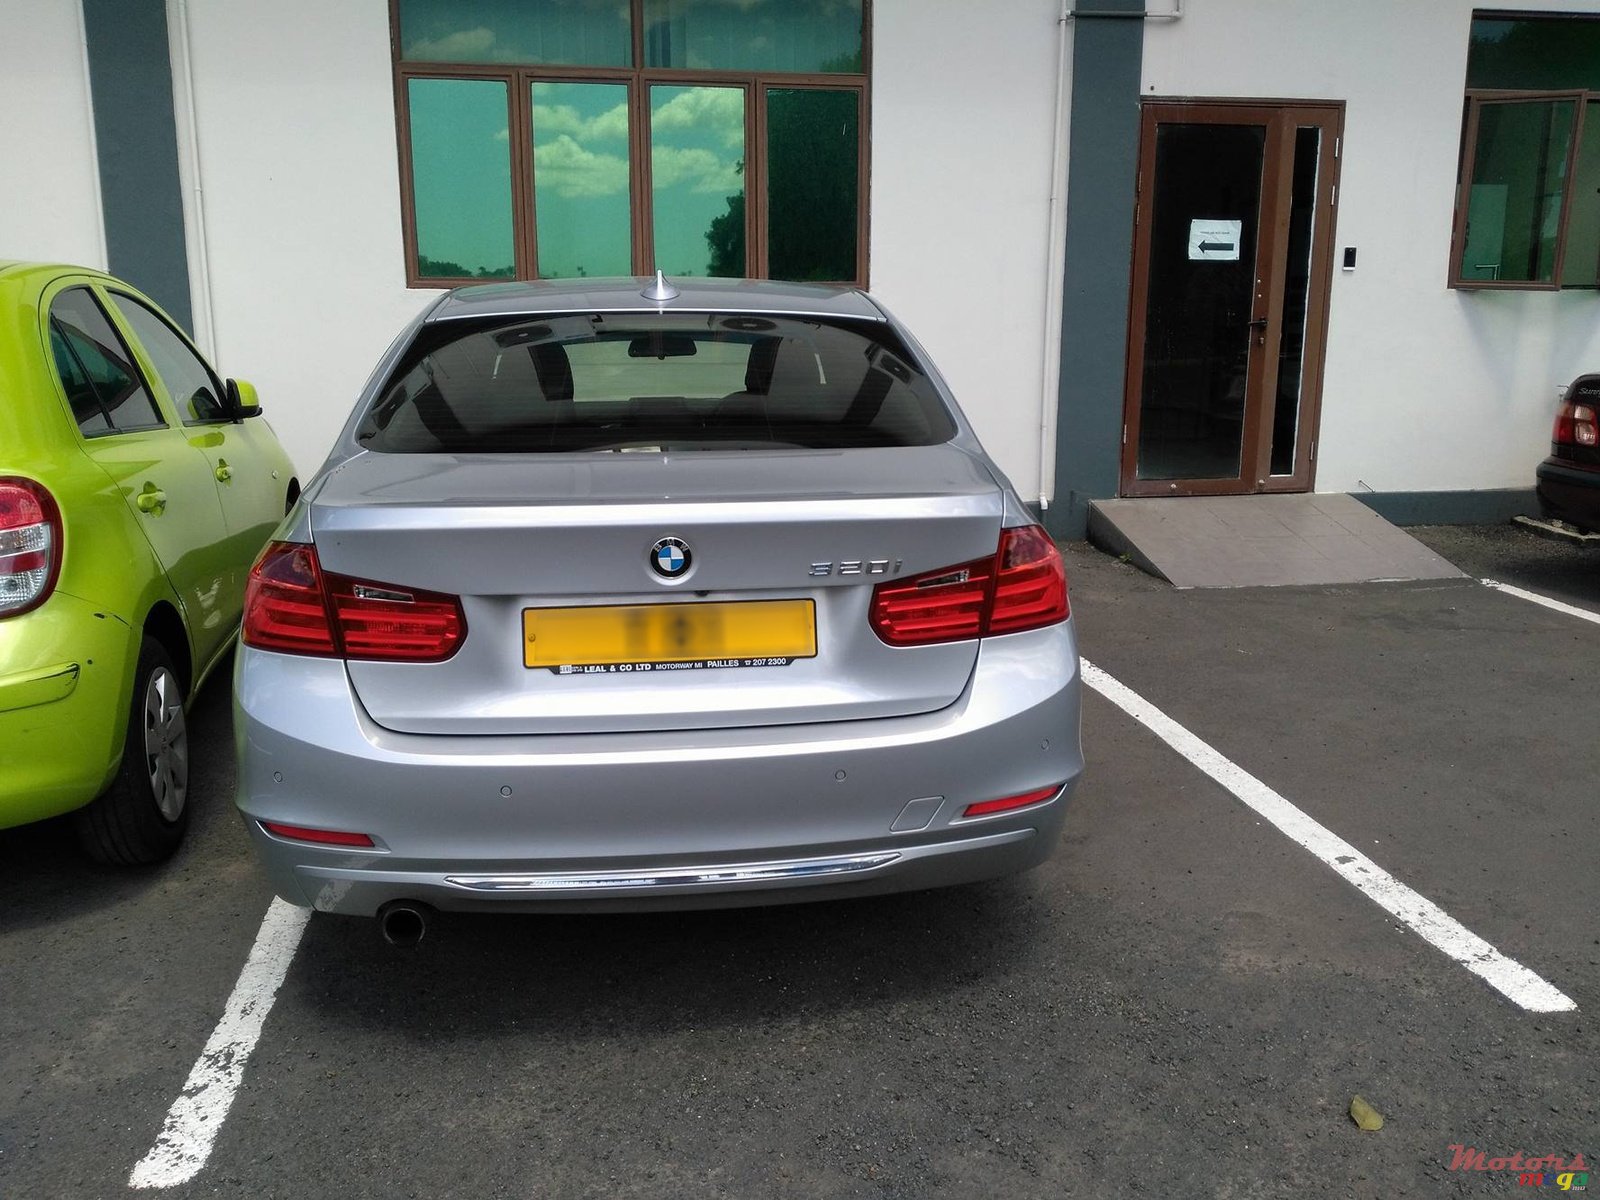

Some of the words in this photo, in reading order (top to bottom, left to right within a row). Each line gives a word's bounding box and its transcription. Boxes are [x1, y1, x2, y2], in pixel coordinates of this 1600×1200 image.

[654, 538, 689, 552] BMW
[808, 559, 902, 576] 320i
[584, 665, 606, 673] LEAL
[610, 664, 616, 672] &
[636, 663, 651, 671] LTD
[655, 662, 693, 670] MOTORWAY
[707, 659, 739, 668] PAILLES
